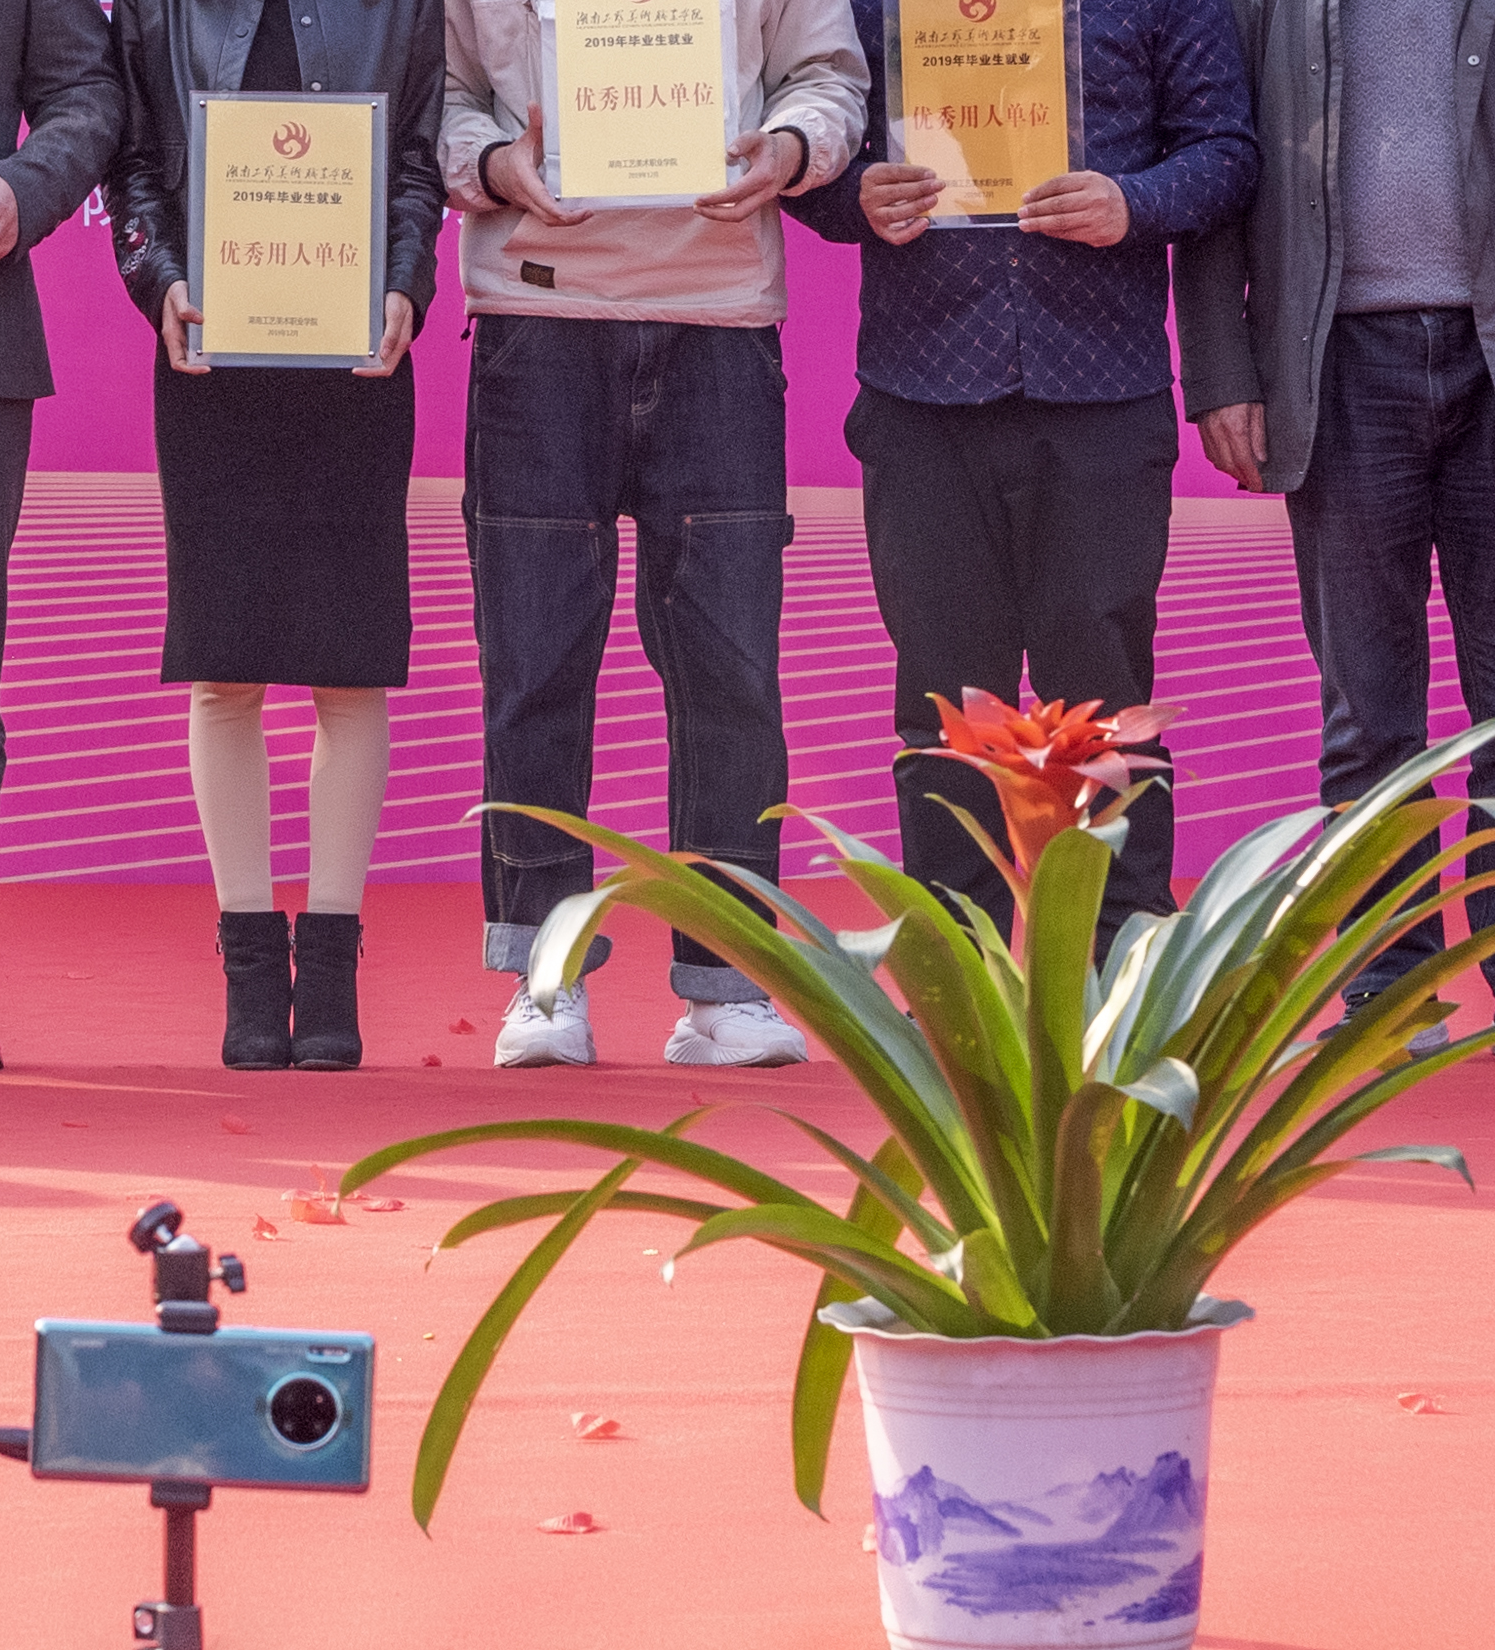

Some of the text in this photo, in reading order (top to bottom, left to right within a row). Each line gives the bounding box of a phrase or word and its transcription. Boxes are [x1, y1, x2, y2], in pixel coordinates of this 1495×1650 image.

[584, 33, 694, 48] 2019年毕业生就业
[922, 53, 1031, 67] 2019年毕业生就业
[575, 81, 715, 112] 优秀用人单位
[913, 102, 1050, 130] 优秀用人单位
[233, 191, 343, 205] 2019年毕业生就业
[219, 240, 359, 268] 优秀用人单位
